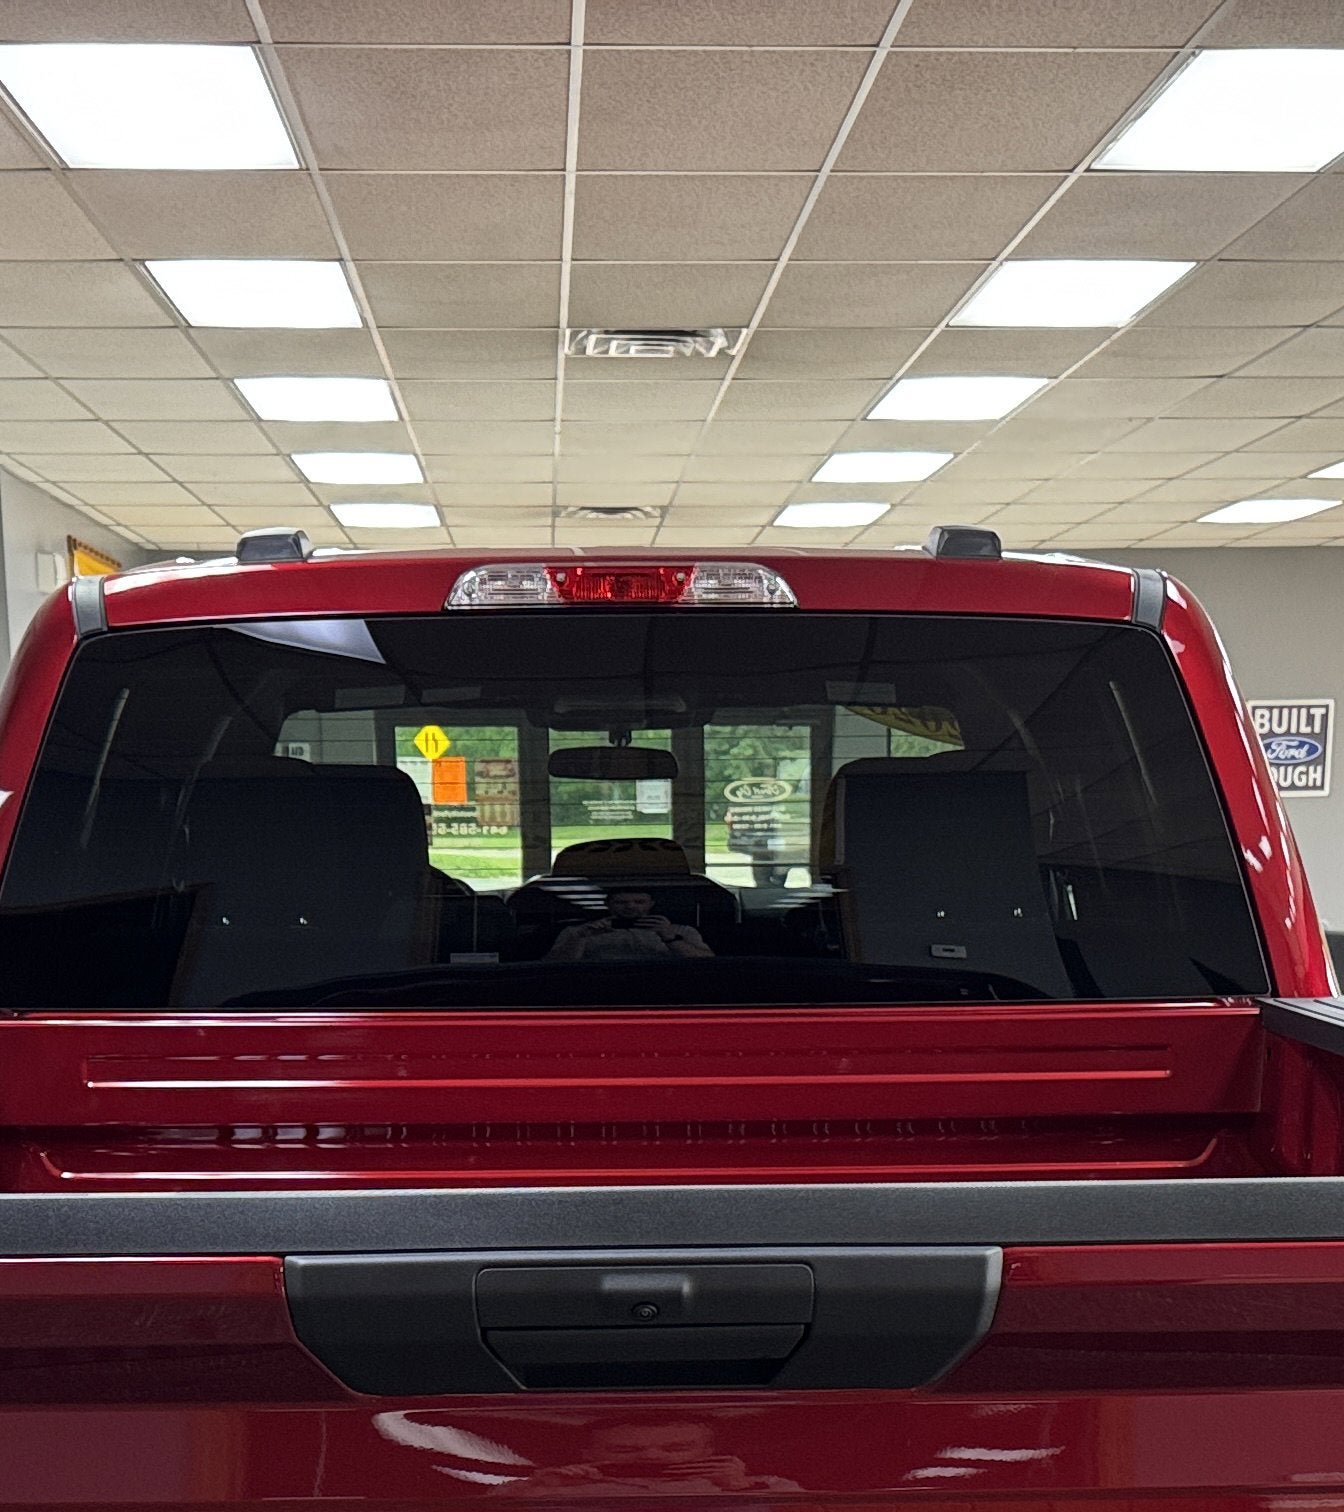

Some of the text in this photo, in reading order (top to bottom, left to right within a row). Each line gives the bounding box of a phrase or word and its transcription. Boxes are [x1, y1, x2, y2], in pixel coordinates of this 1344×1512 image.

[1254, 707, 1327, 734] BUILT
[1267, 740, 1309, 759] Ford
[1271, 765, 1323, 787] UGH
